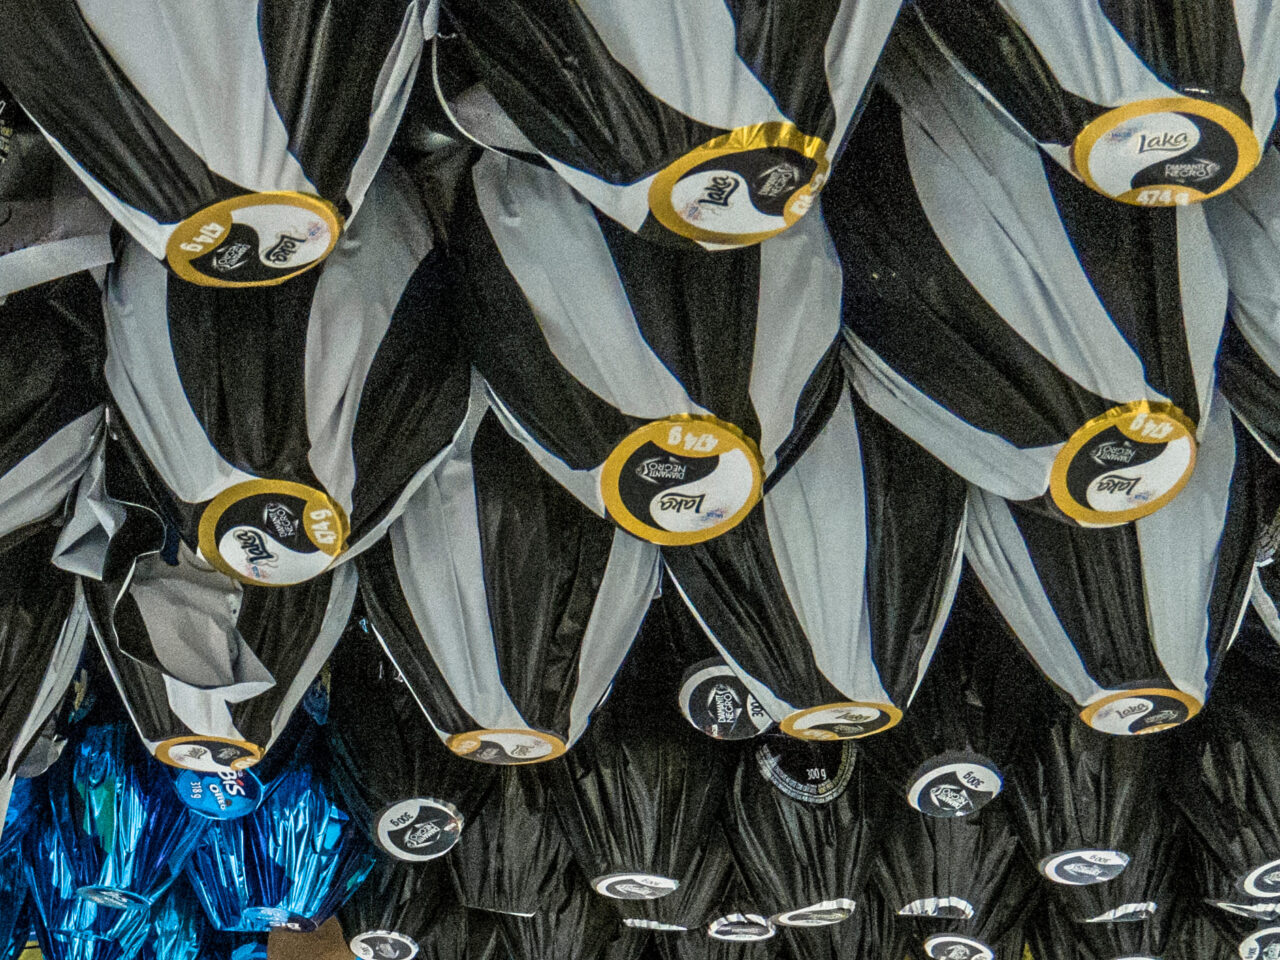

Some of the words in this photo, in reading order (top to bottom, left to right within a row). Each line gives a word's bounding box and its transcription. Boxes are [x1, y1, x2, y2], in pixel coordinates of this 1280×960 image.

[1138, 132, 1189, 154] Laka
[698, 174, 740, 206] Laka
[264, 234, 306, 263] Laka
[1096, 474, 1142, 496] Laka
[660, 492, 706, 514] Laka
[236, 530, 274, 563] Laka
